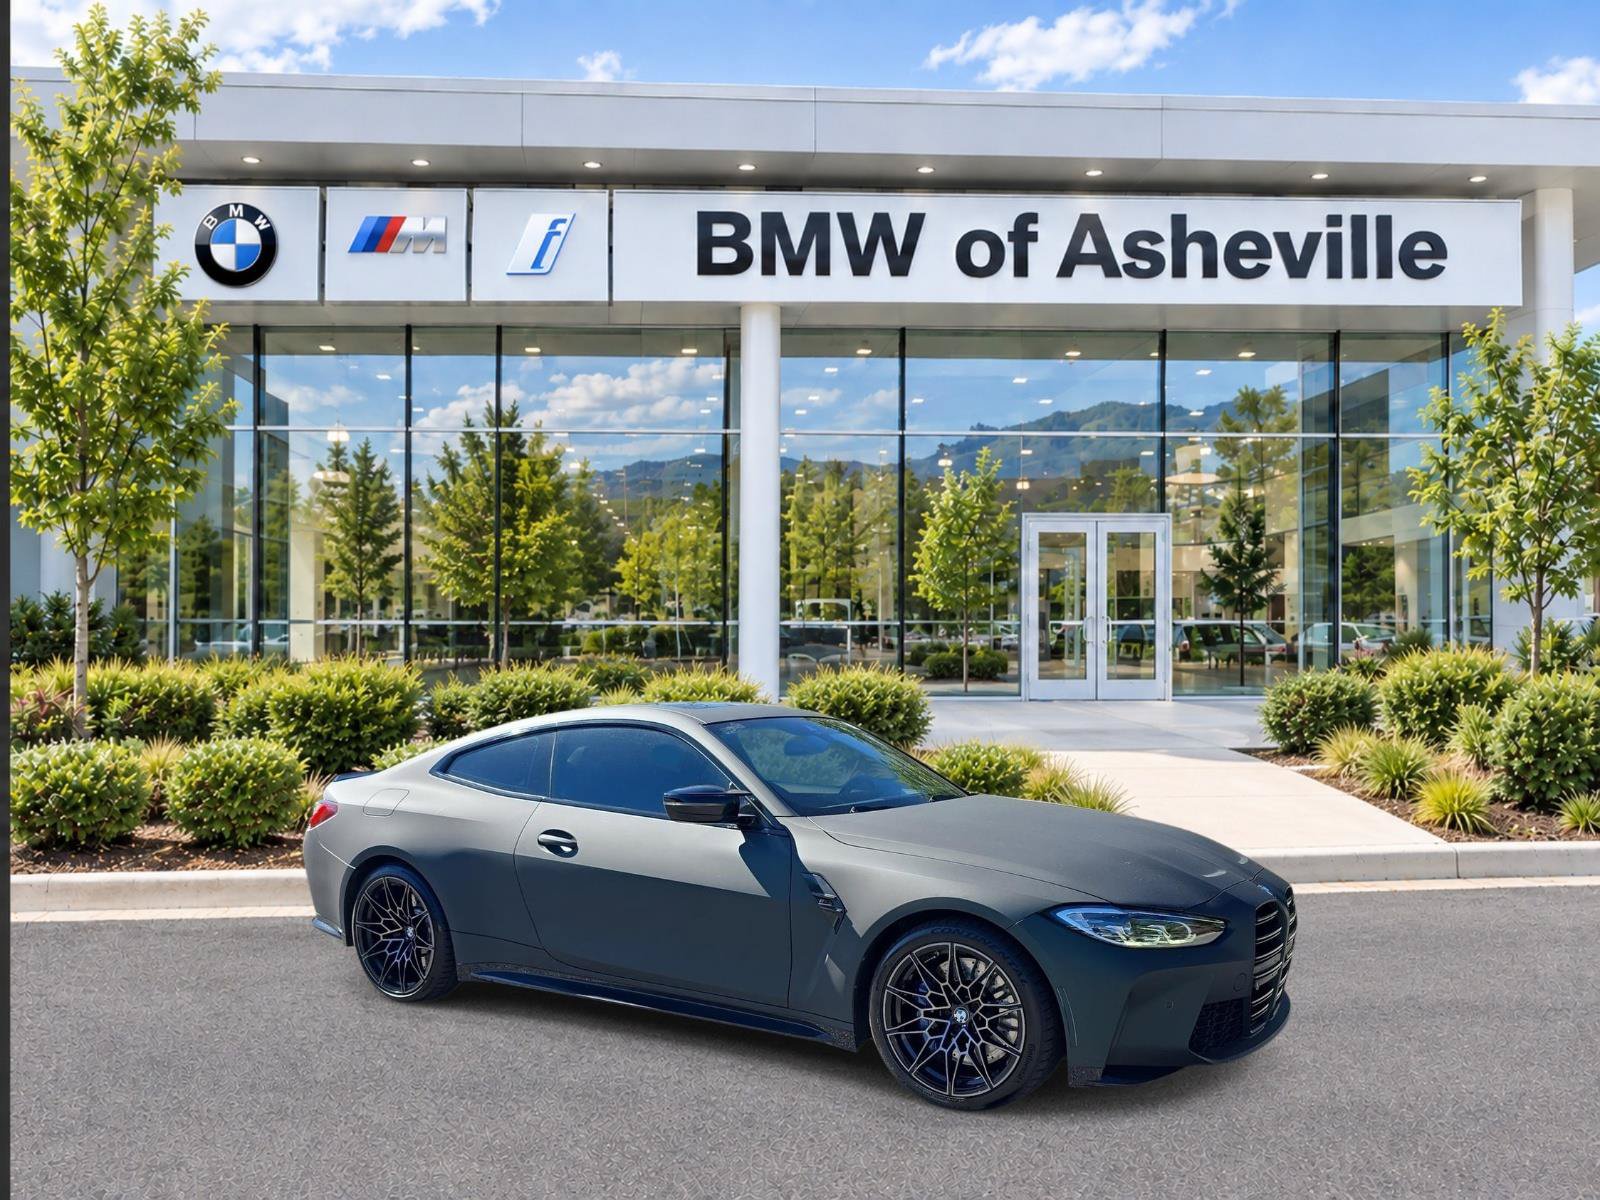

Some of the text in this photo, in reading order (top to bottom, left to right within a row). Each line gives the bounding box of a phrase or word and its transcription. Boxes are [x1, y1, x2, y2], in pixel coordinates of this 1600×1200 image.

[202, 204, 271, 231] BMW
[696, 210, 1448, 281] BMW of Asheville
